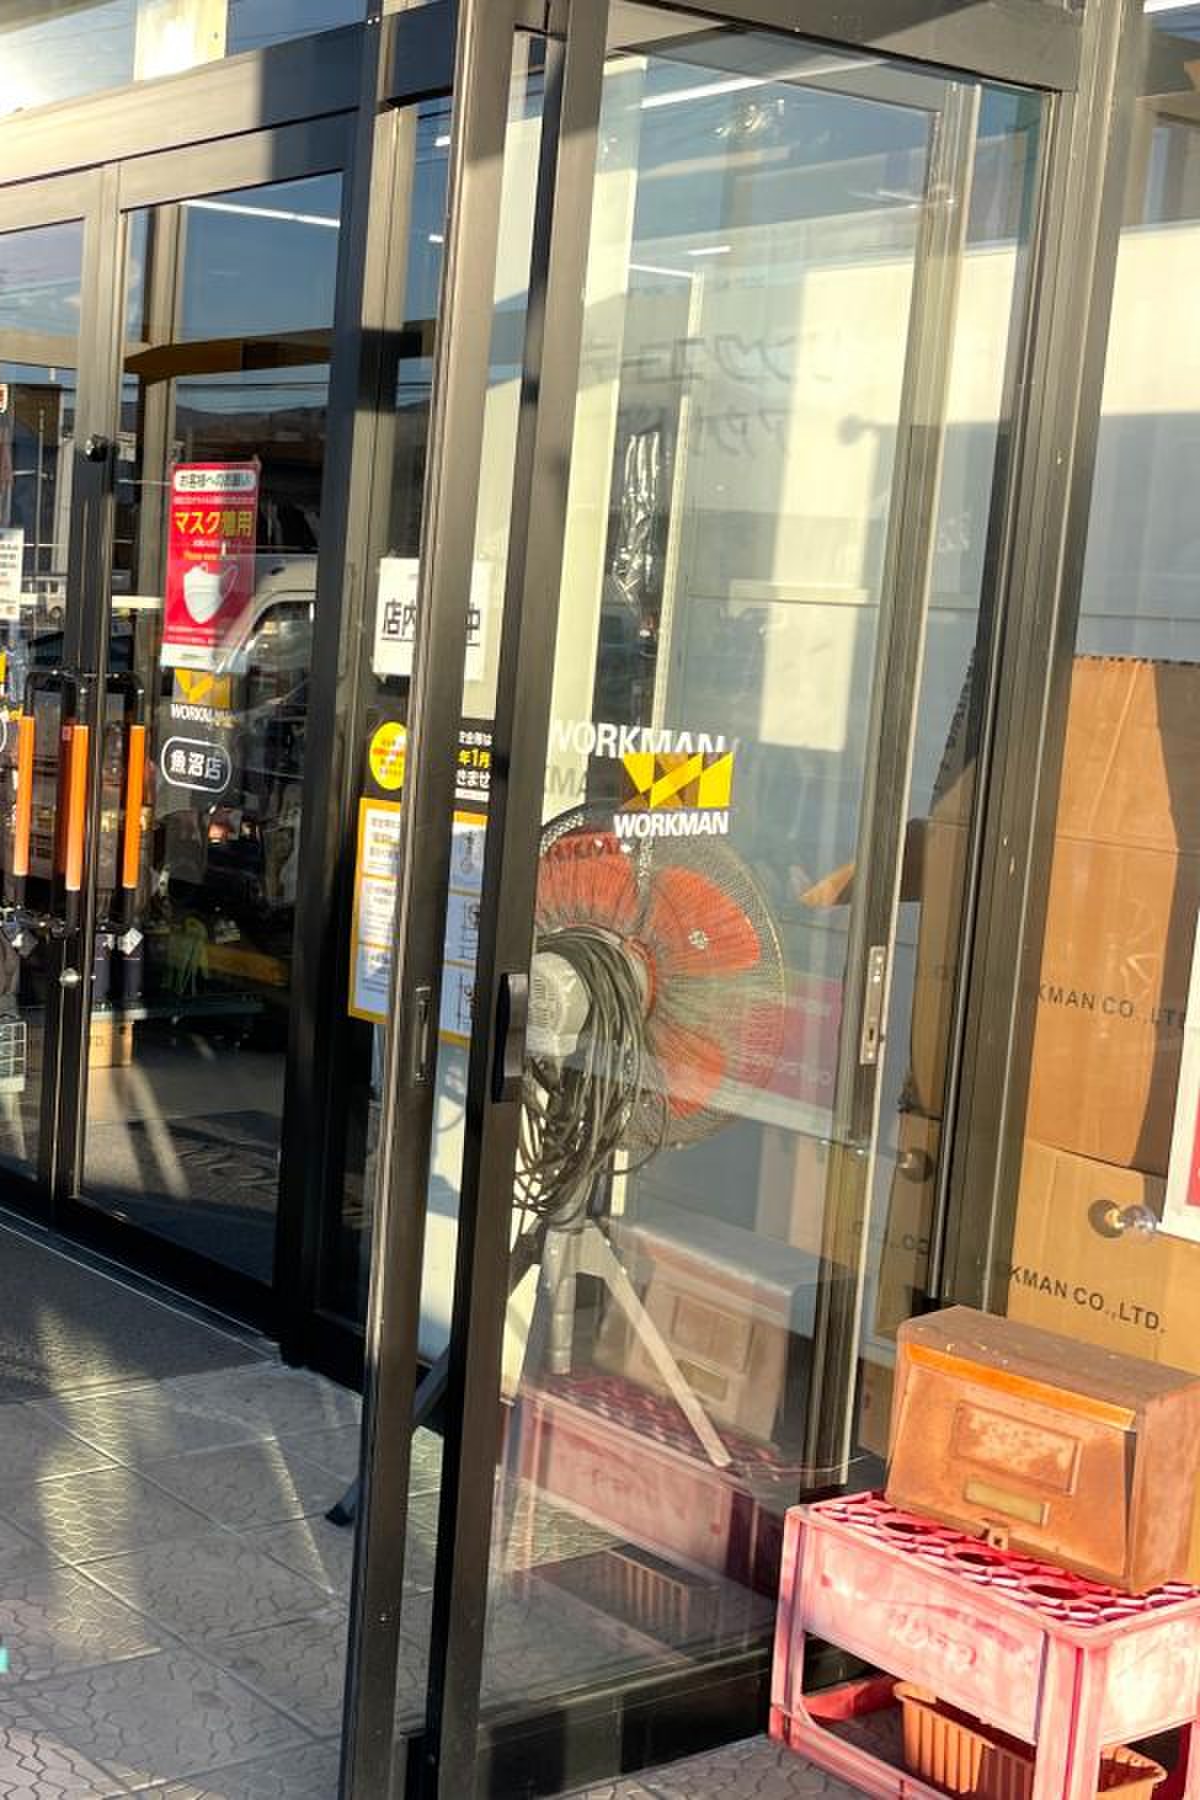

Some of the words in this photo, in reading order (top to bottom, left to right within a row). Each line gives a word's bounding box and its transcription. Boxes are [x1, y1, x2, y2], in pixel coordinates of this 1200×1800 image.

[169, 748, 222, 780] 魚沼店
[613, 810, 729, 838] WORKMAN
